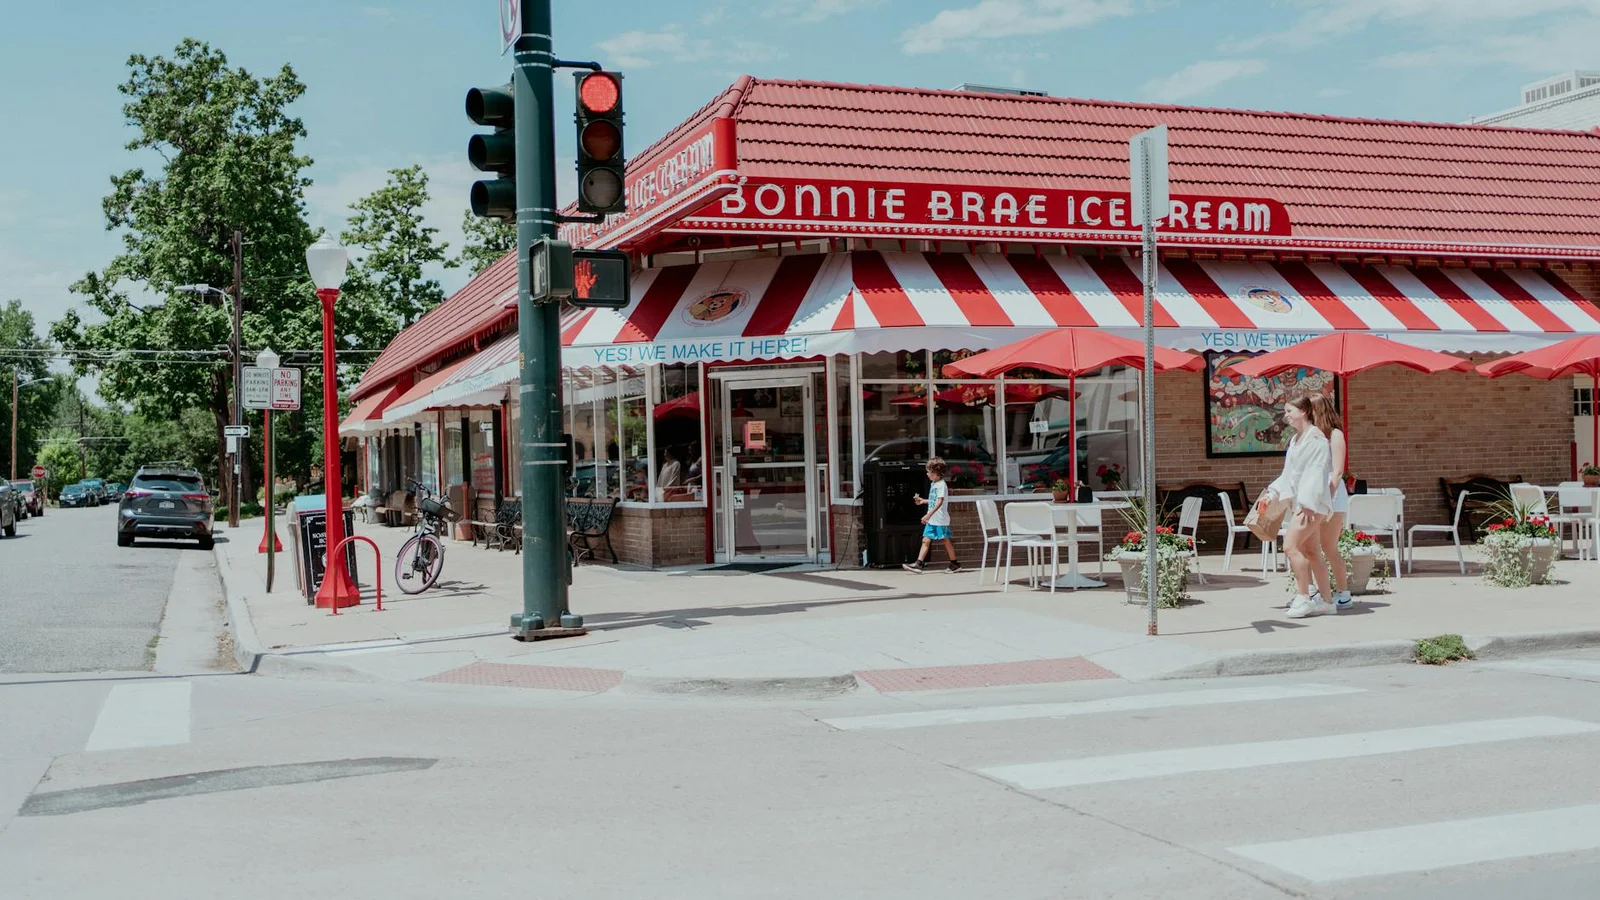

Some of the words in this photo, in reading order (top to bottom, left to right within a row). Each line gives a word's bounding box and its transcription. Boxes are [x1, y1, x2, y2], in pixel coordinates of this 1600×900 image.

[721, 183, 906, 220] BONNIE
[927, 190, 1048, 225] BRAE
[1067, 195, 1126, 228] ICE
[1153, 200, 1271, 232] REAM
[1201, 332, 1239, 347] YES!
[1244, 332, 1270, 347] WE
[594, 346, 633, 362] YES!
[639, 345, 667, 360] WE
[672, 342, 723, 359] MAKE
[729, 341, 746, 356] IT
[751, 337, 809, 355] HERE!
[280, 371, 291, 379] NO
[273, 379, 298, 388] PARKING
